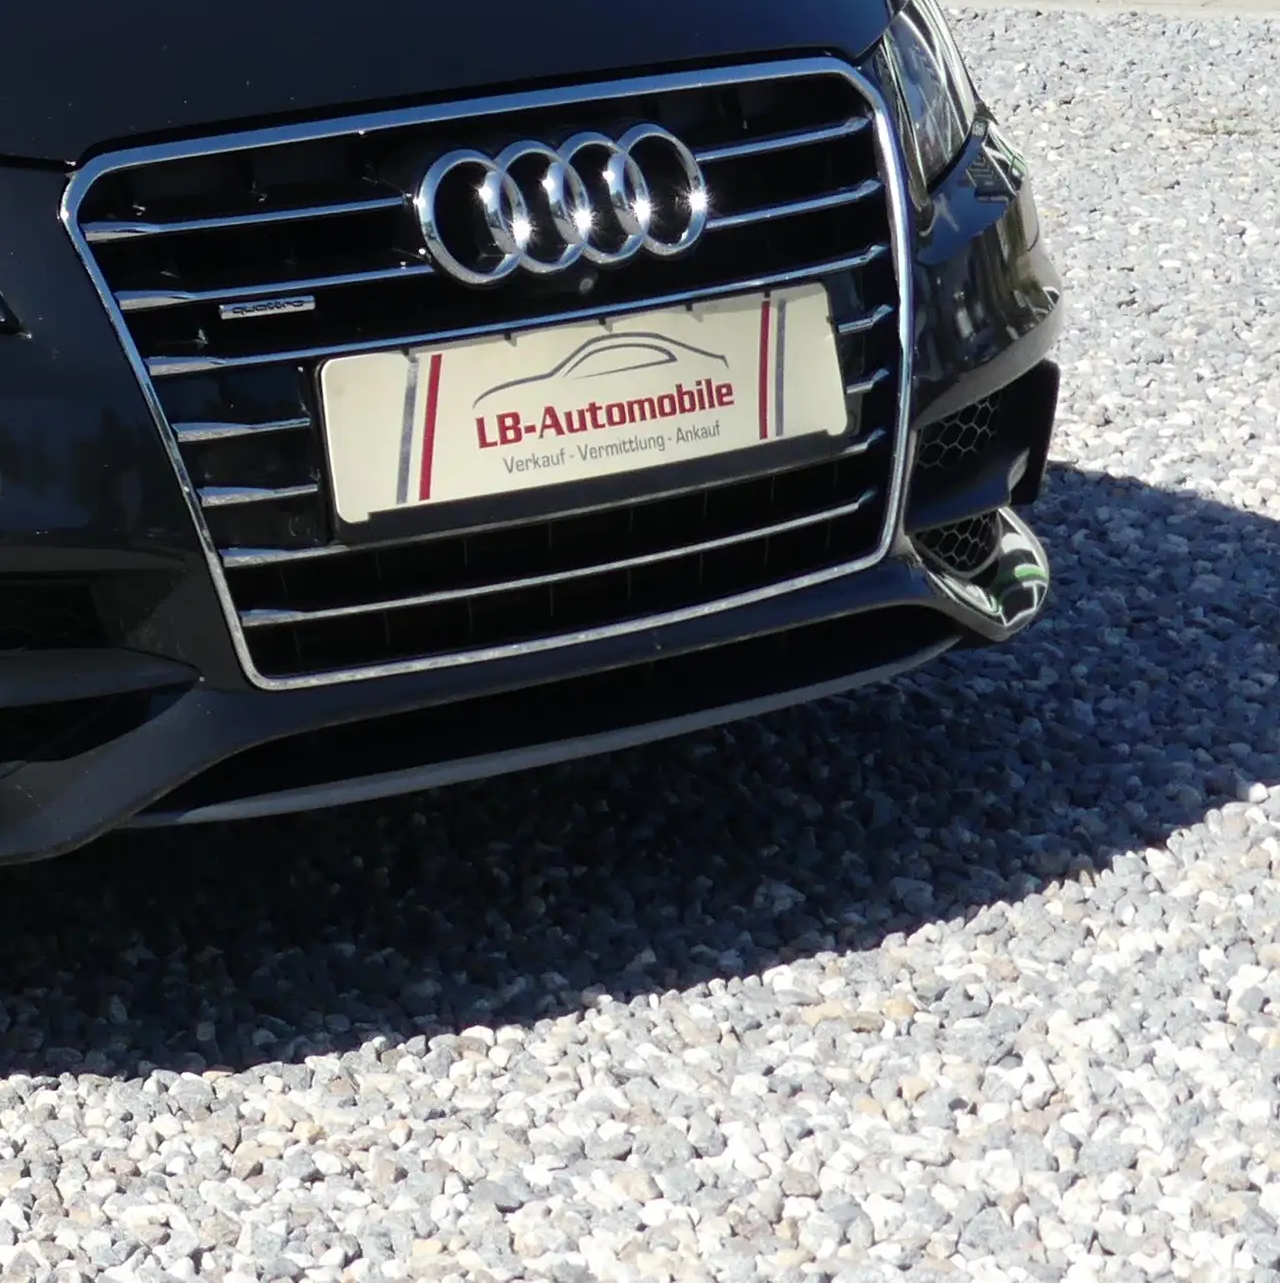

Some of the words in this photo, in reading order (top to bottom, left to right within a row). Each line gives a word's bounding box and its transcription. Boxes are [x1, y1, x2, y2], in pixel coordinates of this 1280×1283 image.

[232, 300, 304, 316] quattro
[475, 378, 734, 449] LB-Automobile
[503, 449, 566, 474] Verkauf
[577, 434, 666, 462] Vermittlung
[675, 420, 721, 444] Ankauf
